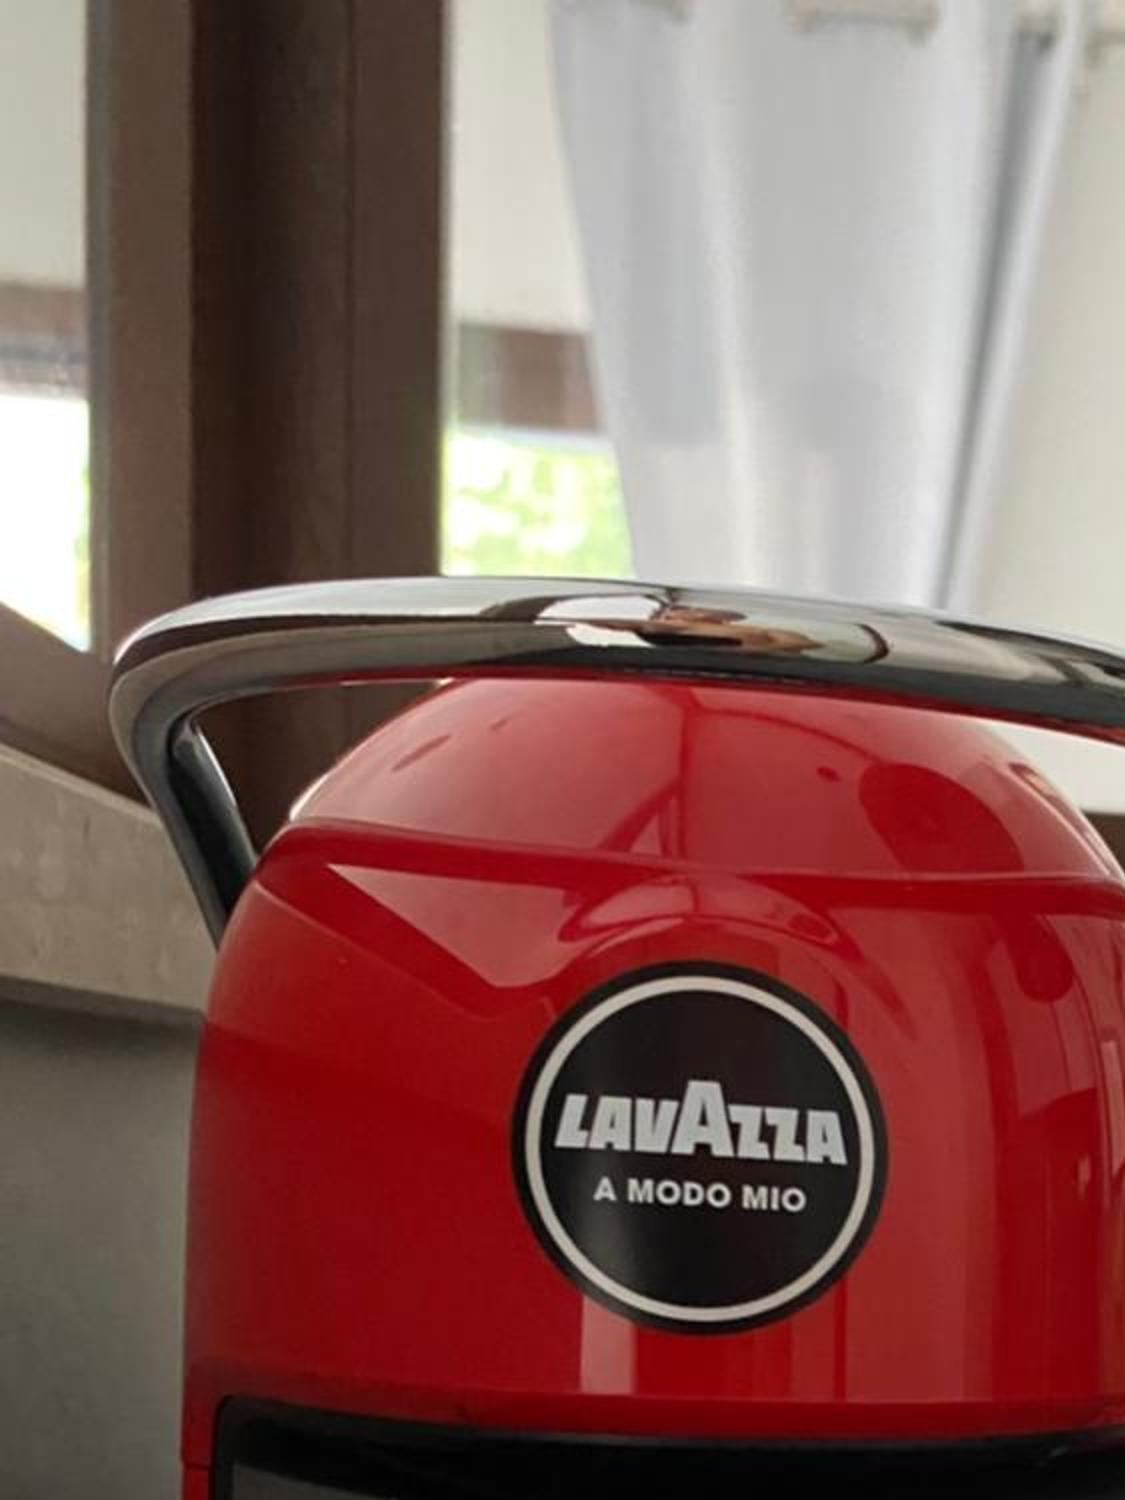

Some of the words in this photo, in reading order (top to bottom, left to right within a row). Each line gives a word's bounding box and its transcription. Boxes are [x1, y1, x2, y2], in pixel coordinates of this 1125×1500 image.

[554, 1079, 848, 1166] LAVAZZA
[593, 1176, 617, 1202] A
[627, 1178, 732, 1207] MODO
[742, 1184, 807, 1213] MIO
